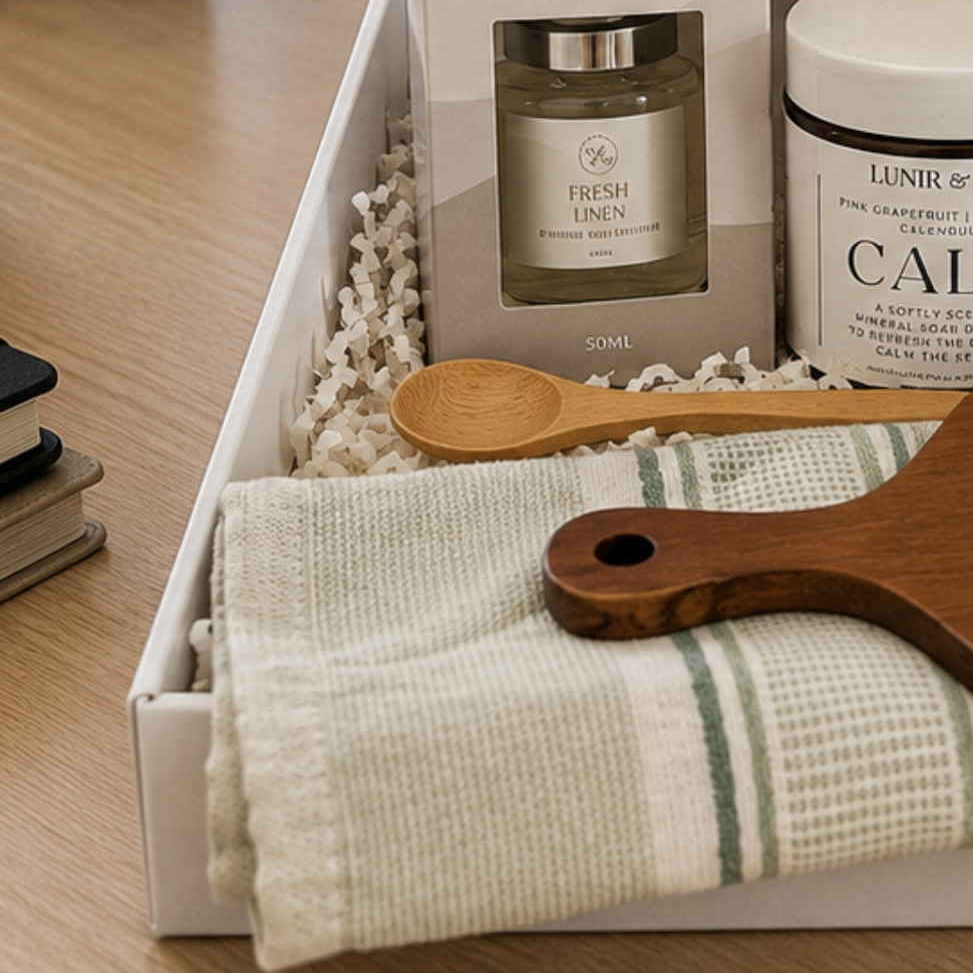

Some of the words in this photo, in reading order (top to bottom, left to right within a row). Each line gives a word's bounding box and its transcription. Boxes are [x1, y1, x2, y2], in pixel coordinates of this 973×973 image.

[949, 172, 971, 190] &
[569, 182, 629, 201] FRESH
[574, 204, 626, 223] LINEN
[839, 196, 868, 213] PINK
[875, 303, 884, 314] A
